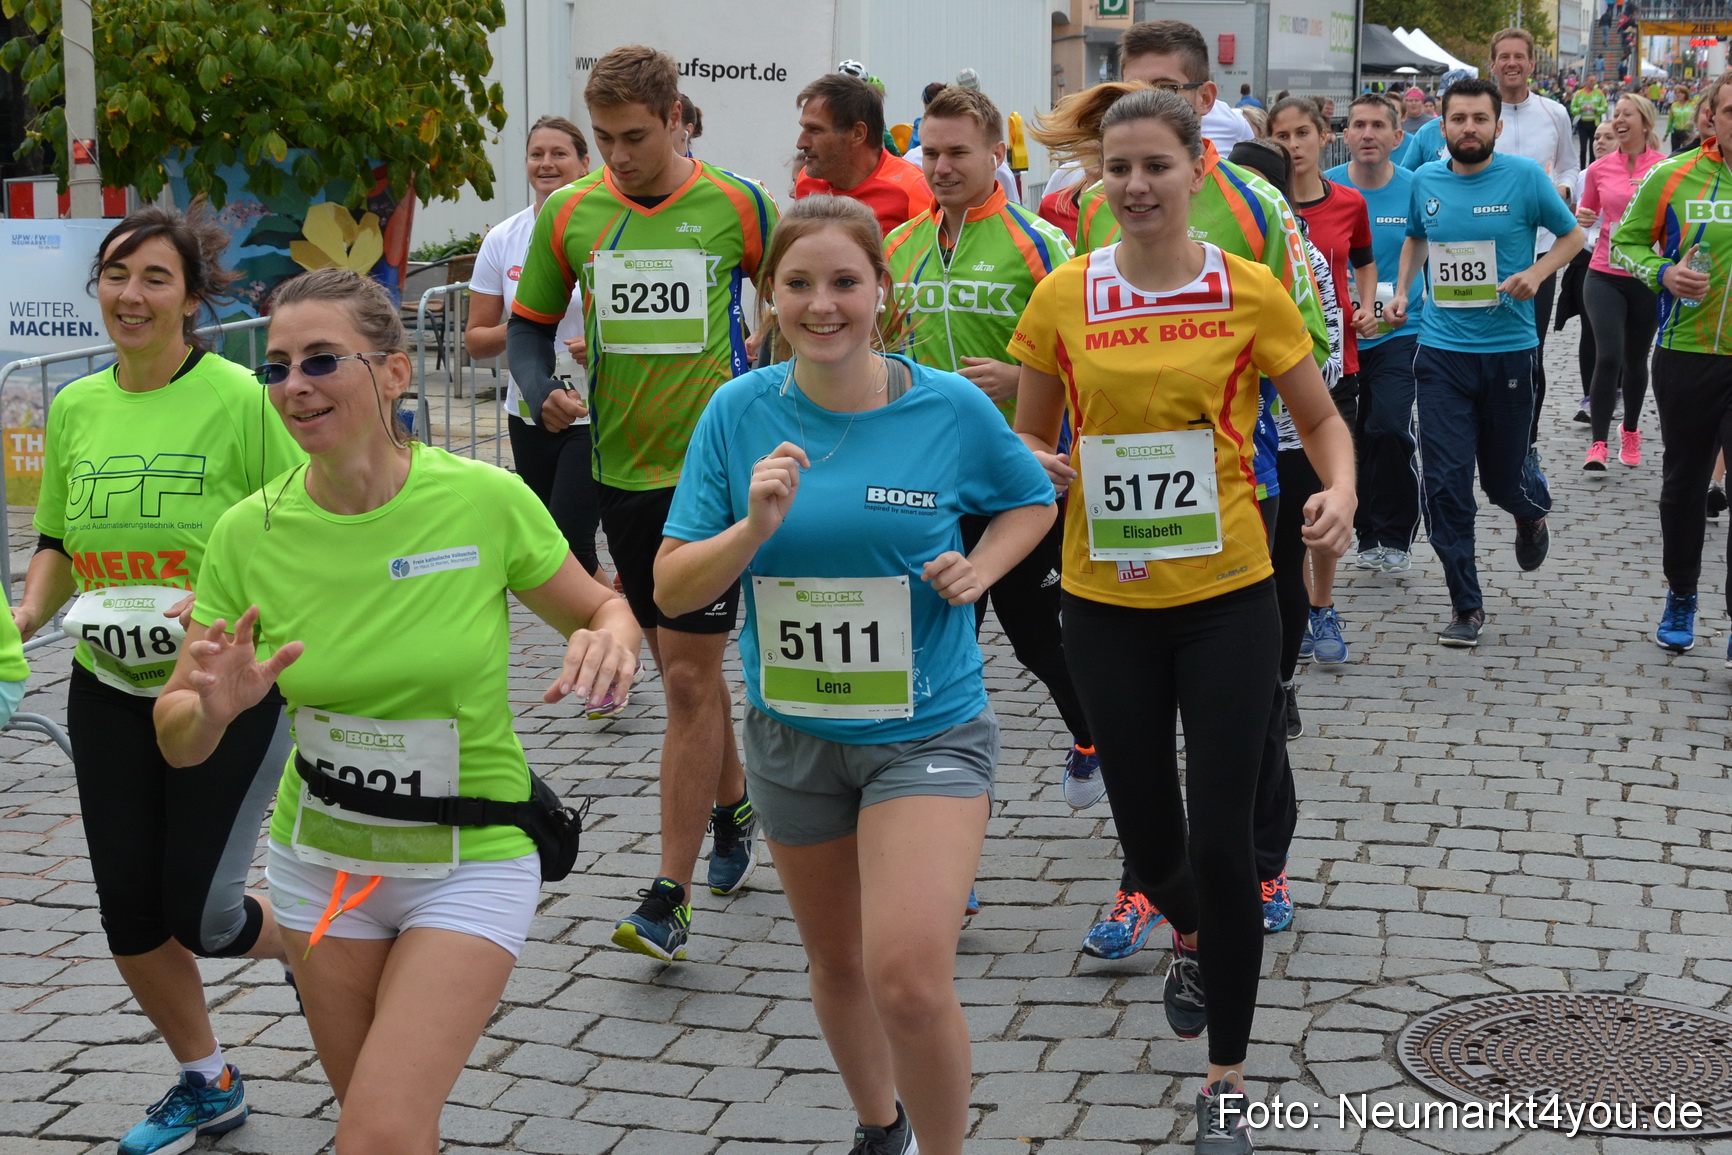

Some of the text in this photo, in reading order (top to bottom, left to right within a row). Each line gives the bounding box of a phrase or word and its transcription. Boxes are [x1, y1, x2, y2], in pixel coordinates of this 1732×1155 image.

[1691, 23, 1718, 34] ZIEL
[1473, 205, 1509, 214] BOCK
[635, 260, 673, 269] BOCK
[1440, 262, 1486, 282] 5183
[611, 282, 690, 314] 5230
[894, 280, 1017, 316] BOCK
[1454, 289, 1473, 297] Khalil
[9, 302, 79, 318] WEITER.
[10, 320, 100, 337] MACHEN.
[1085, 319, 1235, 351] MAX BÖGL
[1128, 444, 1175, 457] BOCK
[866, 486, 938, 509] BOCK
[1103, 470, 1198, 512] 5172
[864, 504, 890, 512] inspired
[177, 521, 203, 530] GmbH
[1123, 523, 1183, 539] Elisabeth
[73, 550, 190, 580] MERZ
[115, 598, 156, 608] BOCK
[811, 591, 864, 603] BOCK
[82, 624, 177, 660] 5018
[779, 620, 880, 663] 5111
[816, 677, 851, 694] Lena
[346, 730, 405, 748] BOCK
